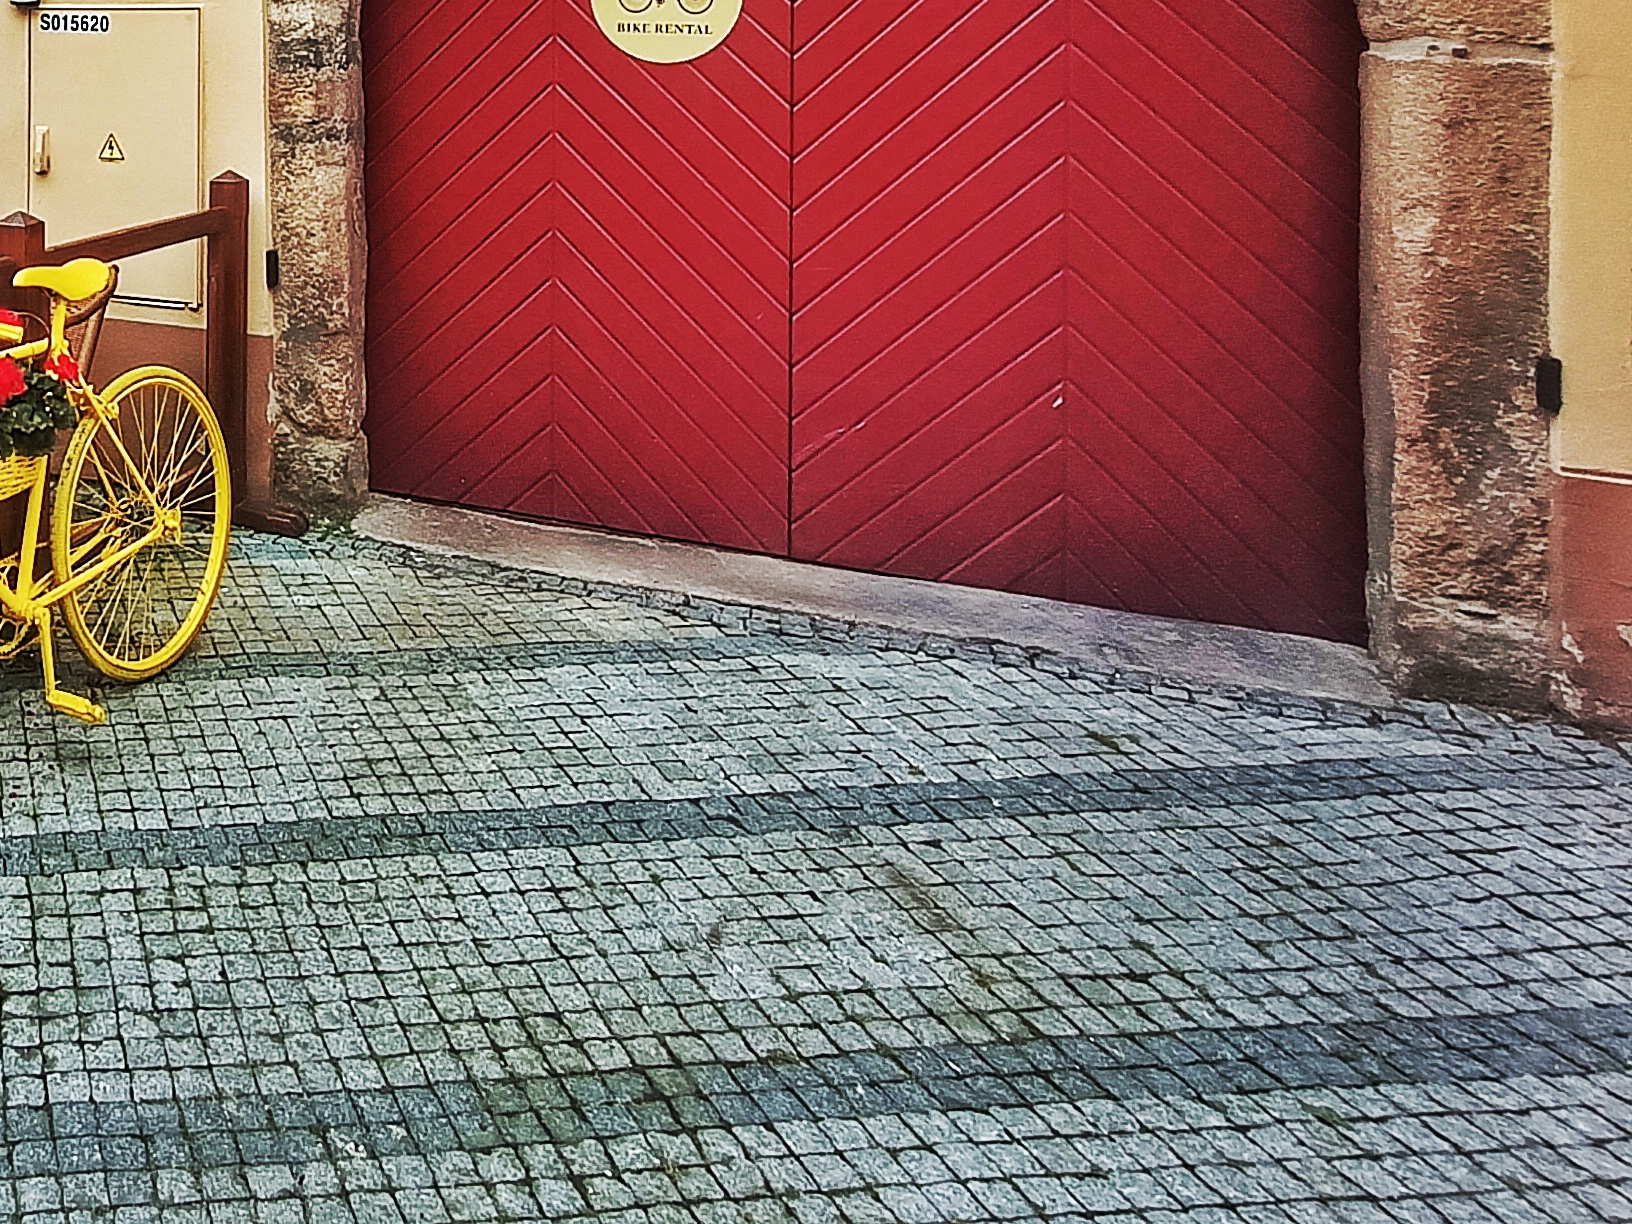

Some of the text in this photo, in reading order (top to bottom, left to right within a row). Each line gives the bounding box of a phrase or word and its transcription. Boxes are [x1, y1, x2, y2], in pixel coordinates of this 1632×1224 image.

[40, 13, 109, 32] S015620
[617, 22, 713, 35] BIKE RENTAL
